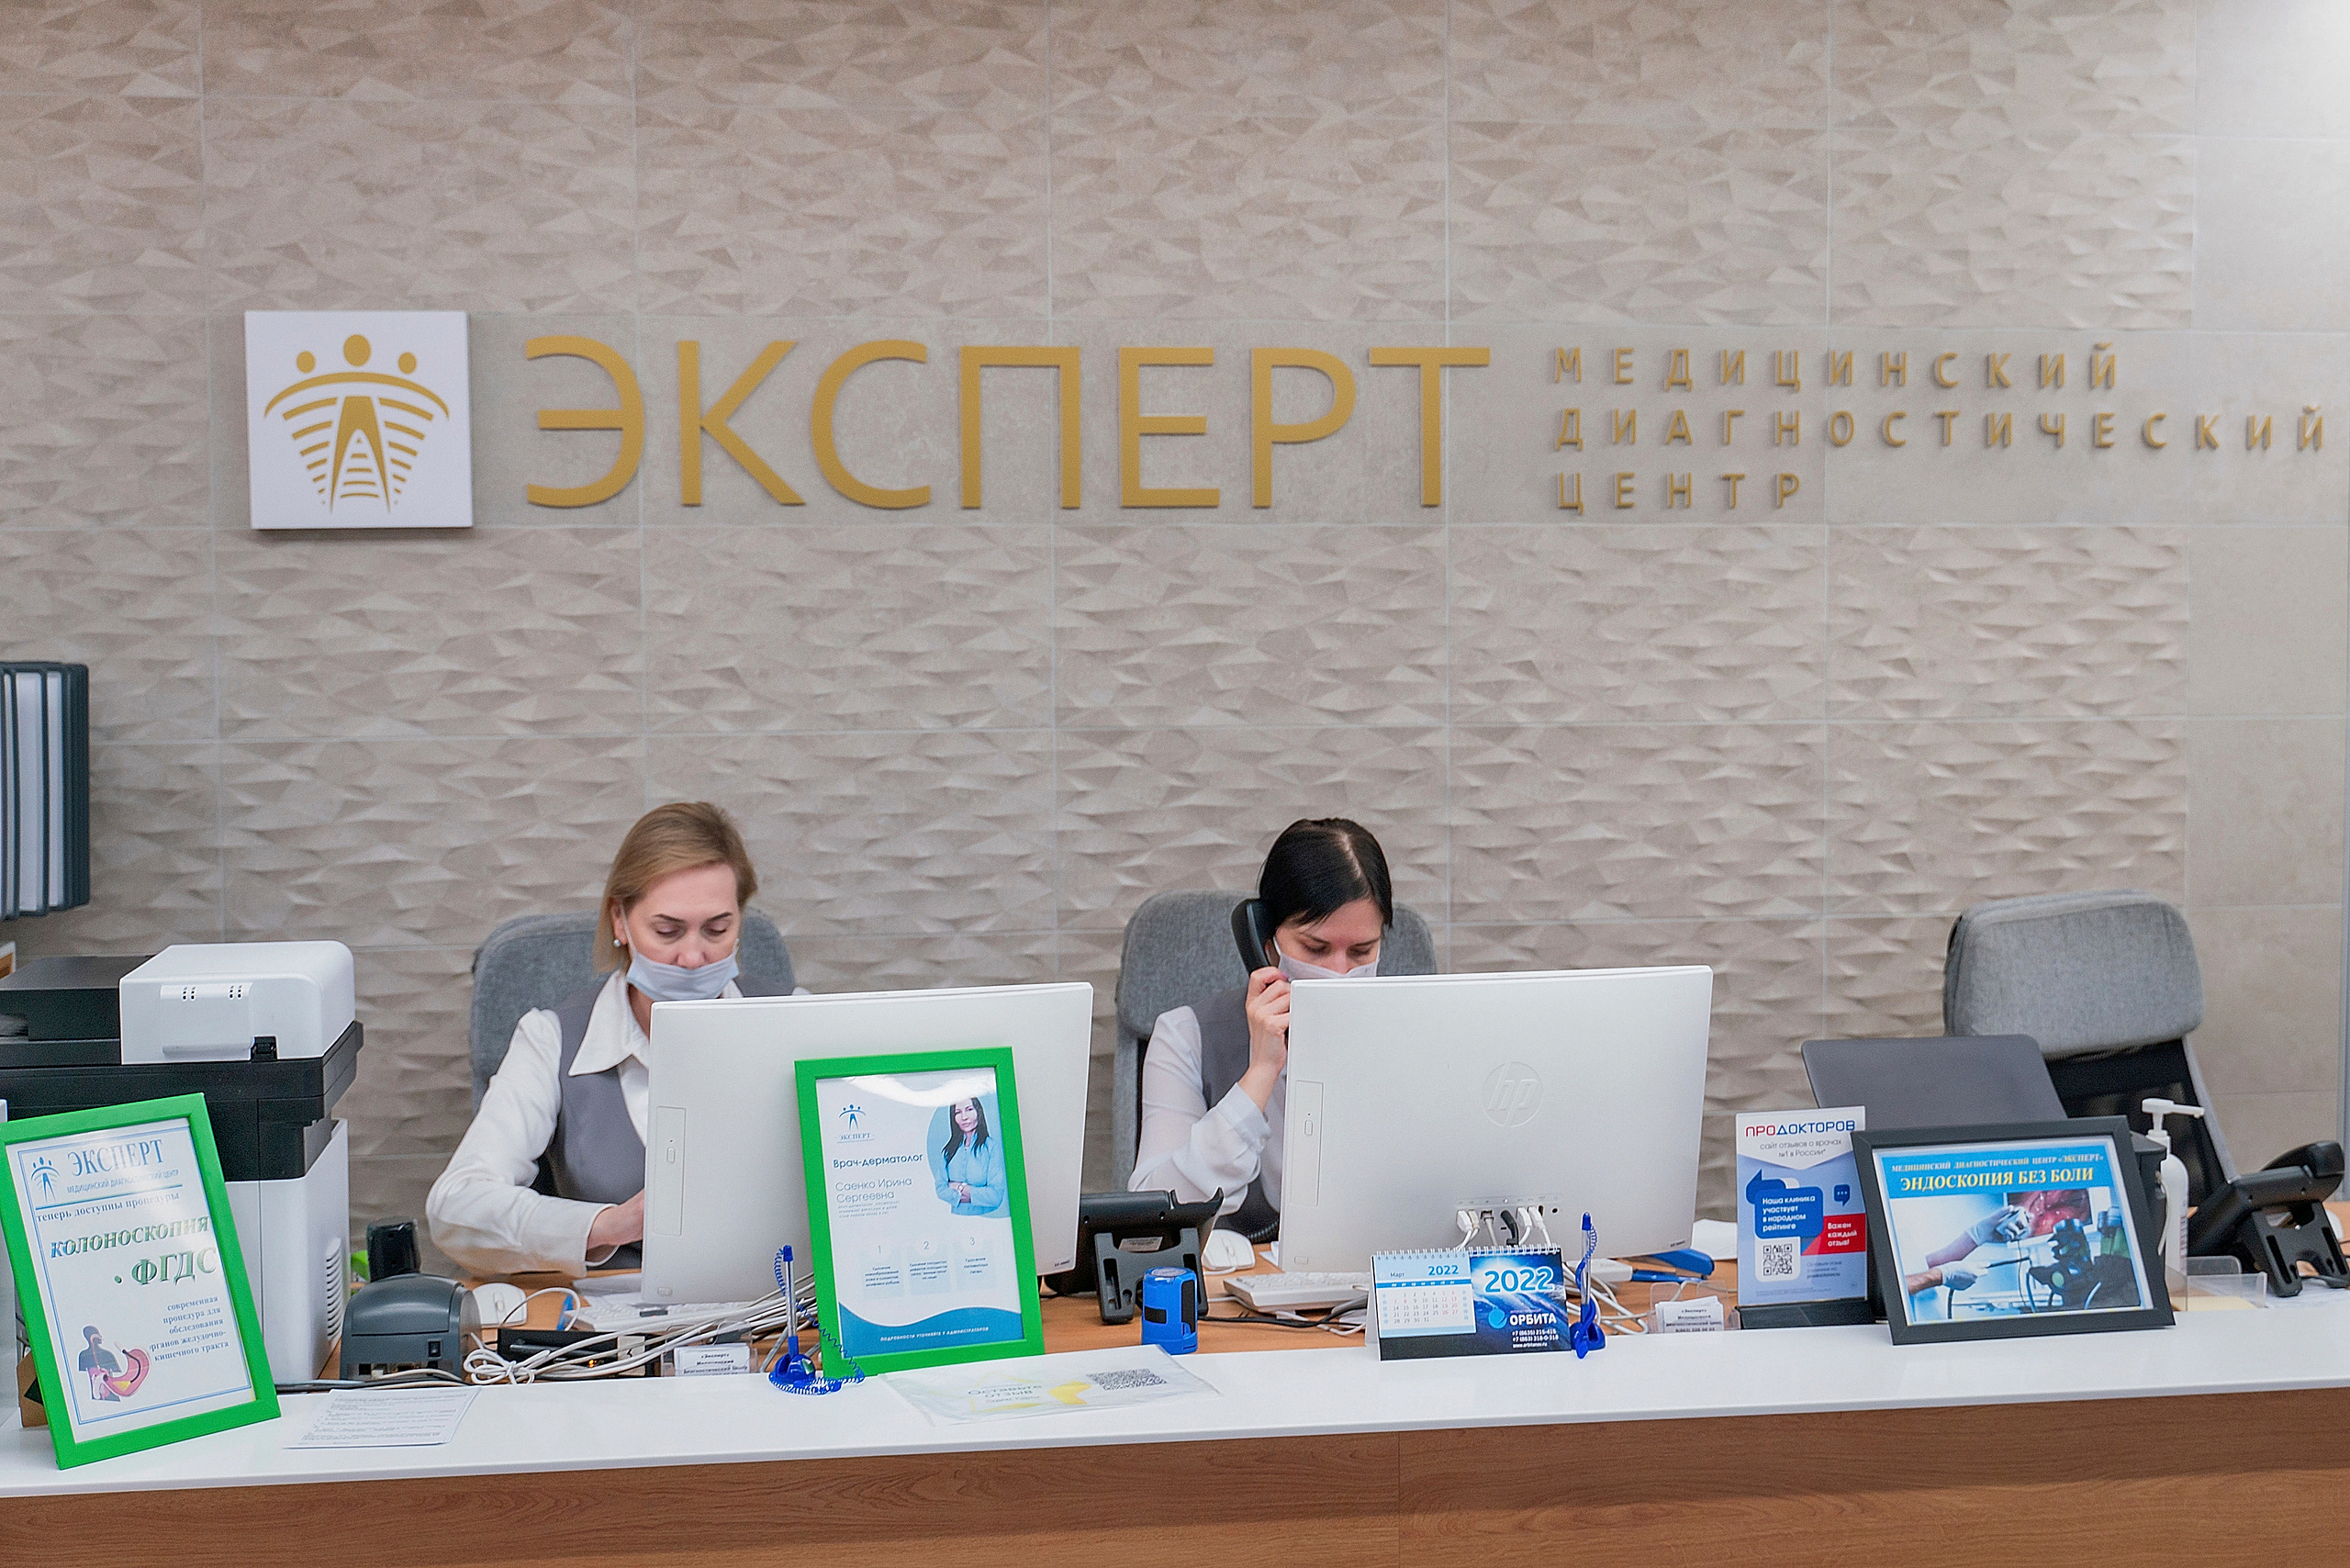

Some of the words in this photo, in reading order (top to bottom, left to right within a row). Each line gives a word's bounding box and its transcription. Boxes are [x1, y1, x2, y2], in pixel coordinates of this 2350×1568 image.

[1554, 342, 2117, 390] МЕДИЦИНСКИЙ
[525, 335, 1491, 510] ЭКСПЕРТ
[1554, 405, 2325, 452] ДИАГНОСТИЧЕСКИЙ
[1555, 472, 1801, 515] ЦЕНТР
[1745, 1120, 1855, 1137] ПРОДОКТОРОВ
[67, 1139, 164, 1177] ЭКСПЕРТ
[833, 1153, 923, 1170] Врач-дерматолог
[1892, 1161, 1952, 1172] МЕДИЦИНСКИЙ
[1953, 1157, 2030, 1170] ДИАГНОСТИЧЕСКИЙ
[2032, 1157, 2057, 1165] ЦЕНТР
[67, 1179, 109, 1193] МЕДИЦИНСКИЙ
[835, 1181, 876, 1192] Саенко
[878, 1178, 912, 1189] Ирина
[1900, 1171, 2014, 1192] ЭНДОСКОПИЯ
[2019, 1170, 2047, 1184] БЕЗ
[2051, 1167, 2093, 1182] БОЛИ
[836, 1191, 895, 1204] Сергеевна
[1785, 1195, 1816, 1204] клиника
[37, 1211, 72, 1222] теперь
[74, 1202, 123, 1217] доступны
[1762, 1205, 1798, 1215] участвует
[1768, 1214, 1806, 1223] народном
[1762, 1223, 1796, 1233] рейтинге
[923, 1241, 929, 1250] 2
[970, 1237, 975, 1246] 3
[131, 1247, 217, 1286] ФГДС
[1428, 1265, 1459, 1276] 2022
[1483, 1267, 1554, 1293] 2022
[167, 1296, 218, 1311] современная
[162, 1311, 205, 1325] процедура
[1510, 1313, 1557, 1326] ОРБИТА
[169, 1319, 223, 1334] обследования
[149, 1338, 179, 1351] рганов
[154, 1347, 199, 1361] кишечного
[202, 1341, 229, 1353] тракта
